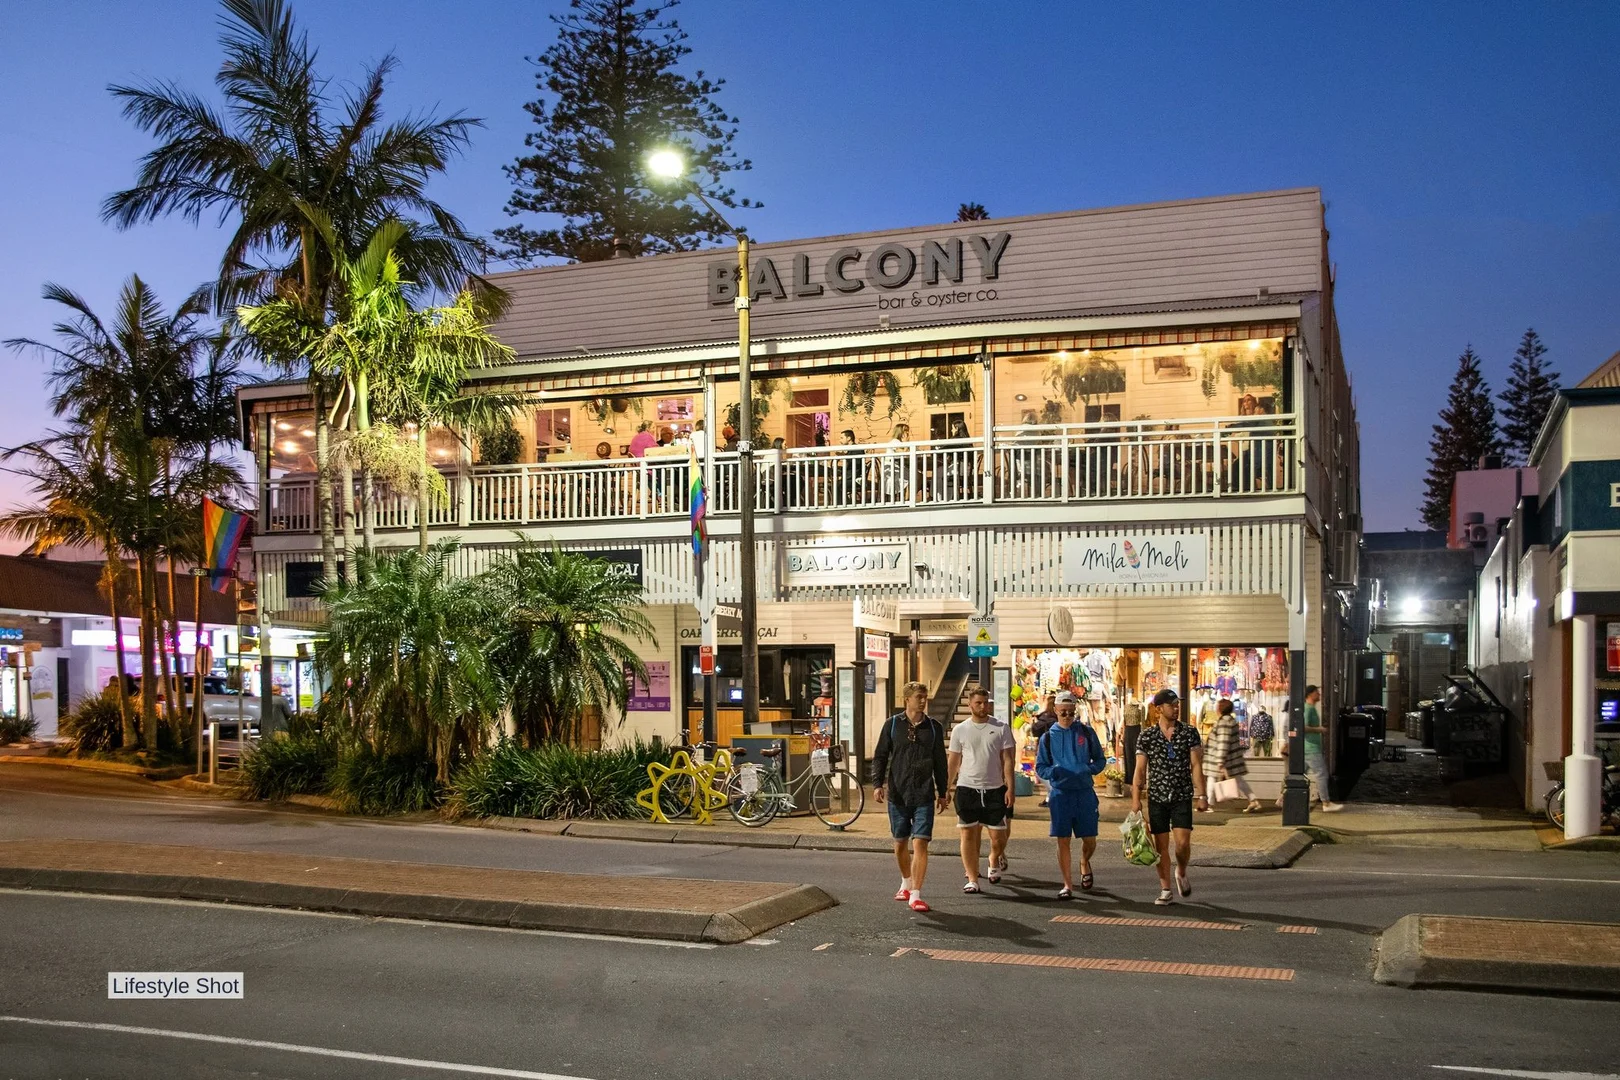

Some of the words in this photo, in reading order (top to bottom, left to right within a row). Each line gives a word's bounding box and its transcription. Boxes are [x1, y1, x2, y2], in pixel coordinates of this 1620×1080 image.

[708, 232, 1011, 308] BALCONY
[879, 295, 905, 310] bar
[911, 291, 922, 307] &
[927, 290, 972, 308] oyster
[976, 289, 999, 301] co.
[787, 551, 902, 573] BALCONY
[1082, 542, 1126, 573] Mila
[861, 599, 897, 620] BALCONY
[757, 627, 778, 640] ÇAI
